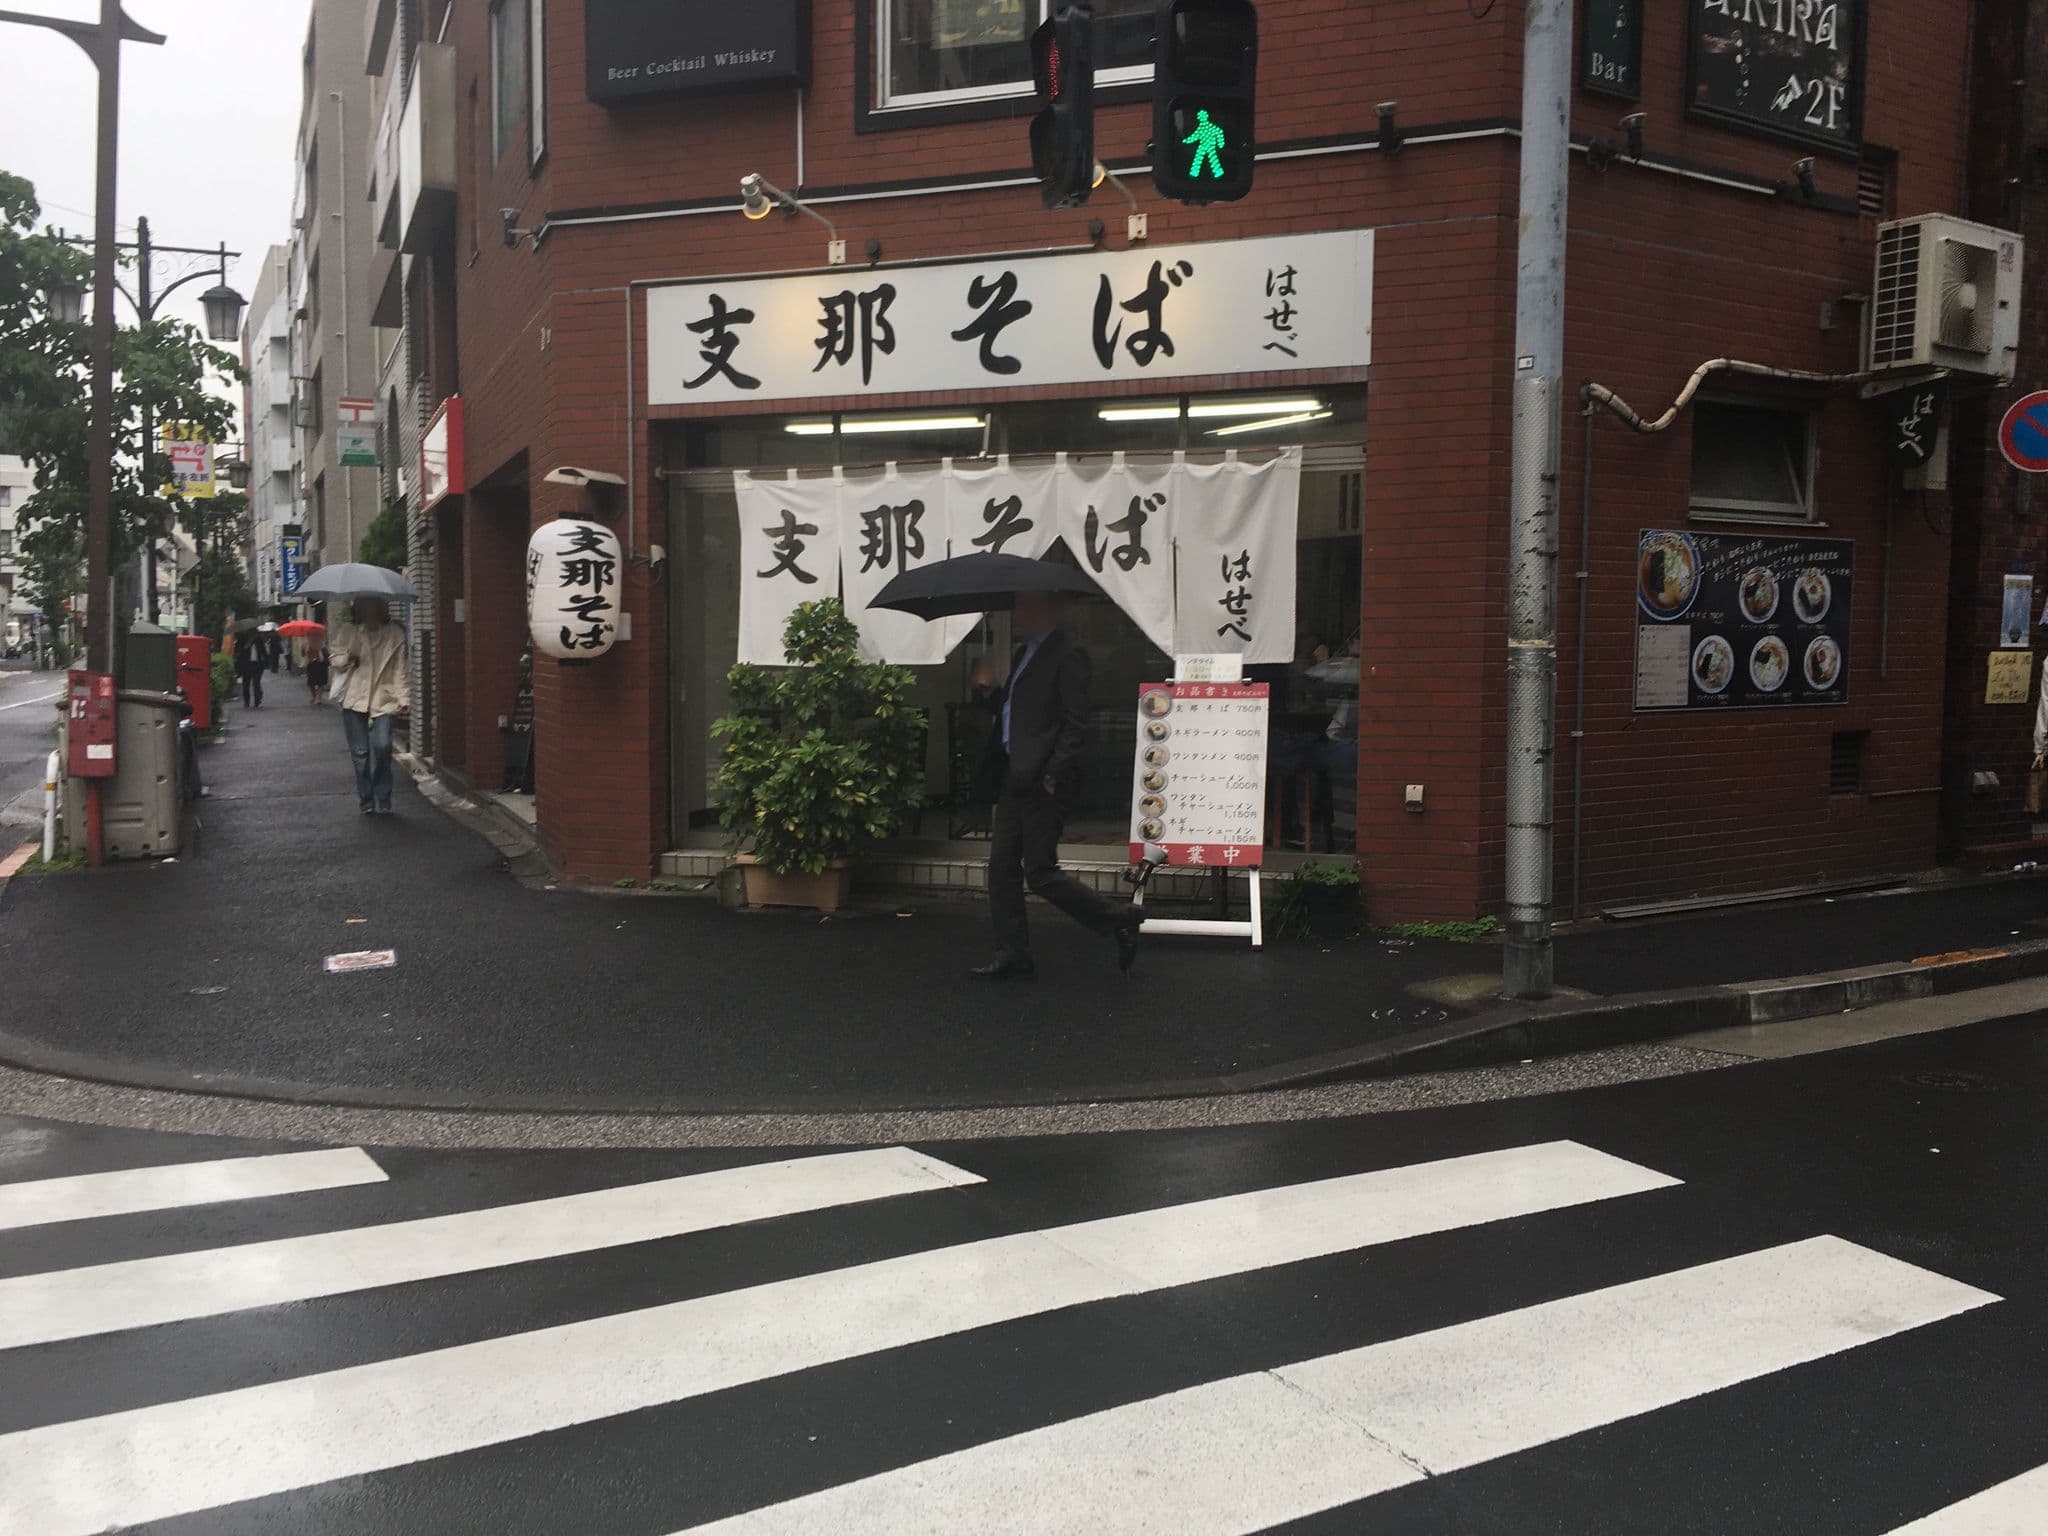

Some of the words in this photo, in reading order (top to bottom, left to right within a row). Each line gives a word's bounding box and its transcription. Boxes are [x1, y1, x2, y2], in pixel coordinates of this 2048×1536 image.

[607, 65, 639, 81] Beer
[646, 54, 706, 76] Cocktail
[714, 48, 776, 68] Whiskey
[1591, 52, 1627, 83] Bar
[1804, 78, 1845, 130] 2F
[683, 259, 1193, 390] 支那そば
[1262, 267, 1299, 359] はせべ
[1897, 392, 1935, 458] はせべ
[756, 492, 1167, 584] 支那そば
[556, 525, 617, 650] 支那そば
[1217, 548, 1253, 643] はせべ
[1172, 752, 1229, 761] ワンタンメン
[1156, 845, 1241, 864] 業中
